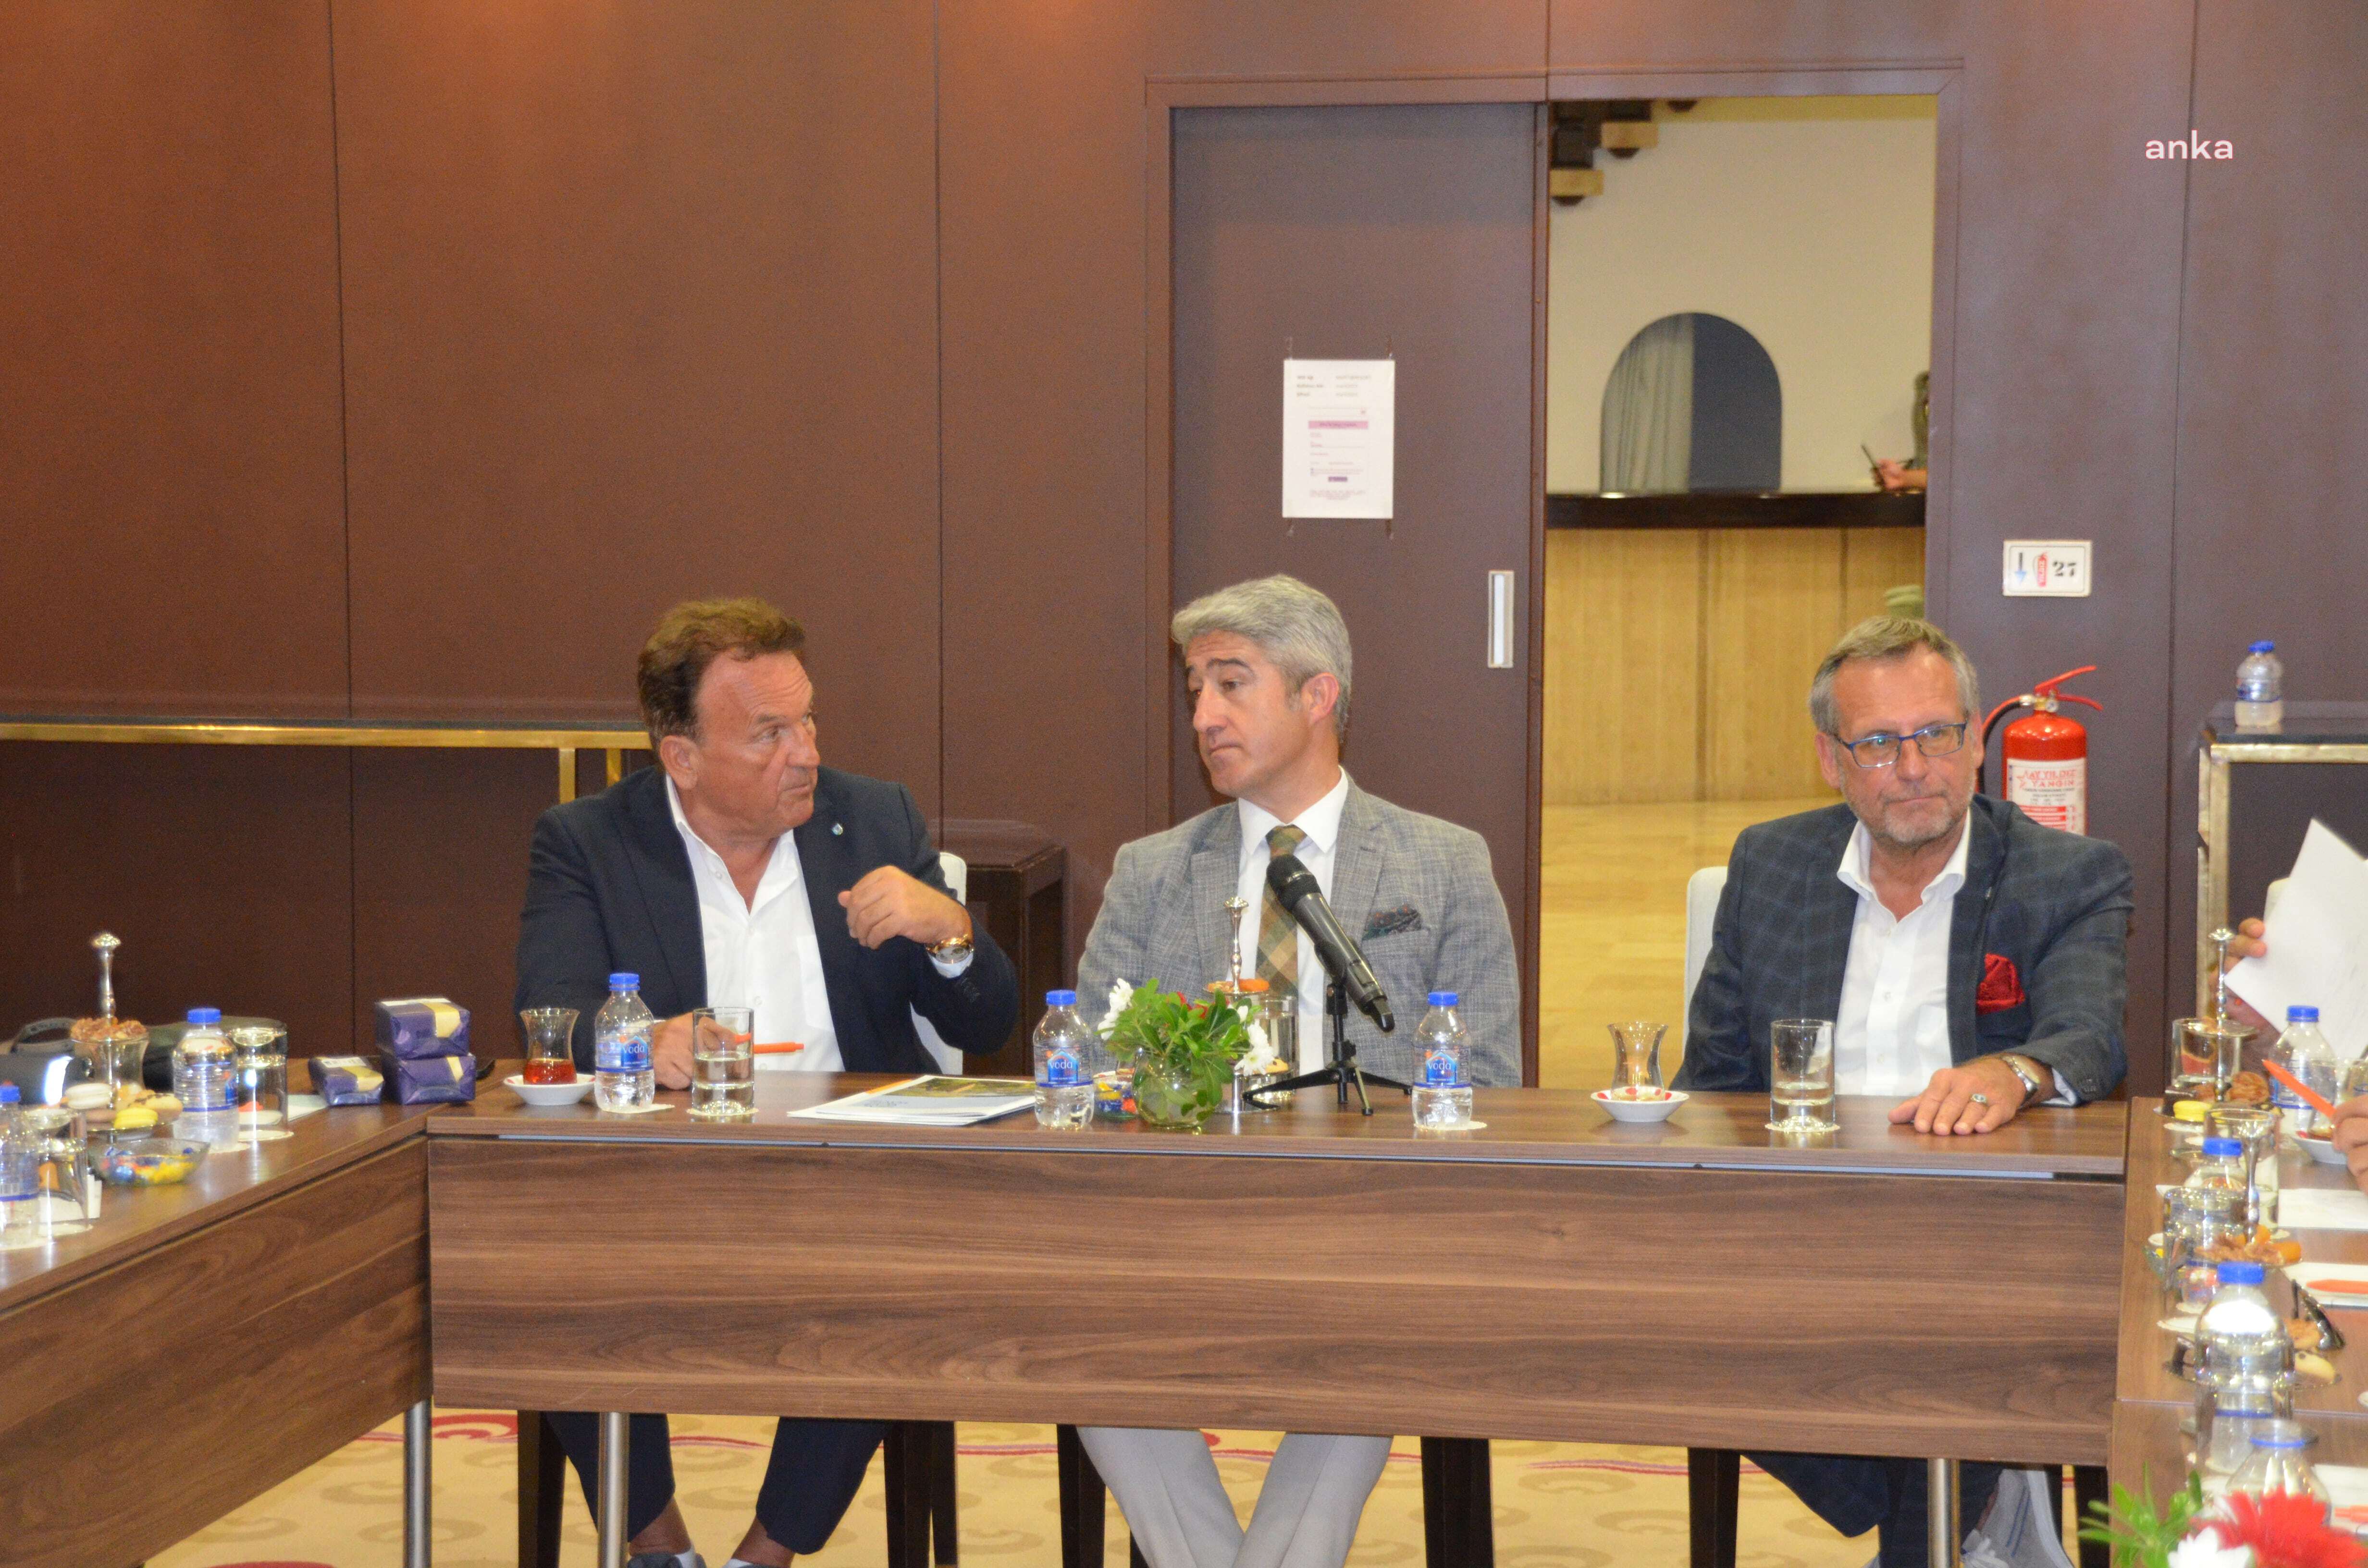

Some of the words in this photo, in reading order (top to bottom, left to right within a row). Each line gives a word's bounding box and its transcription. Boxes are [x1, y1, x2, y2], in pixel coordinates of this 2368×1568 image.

[2052, 561, 2077, 577] 27
[1049, 1059, 1073, 1069] voda
[1427, 1058, 1452, 1070] voda
